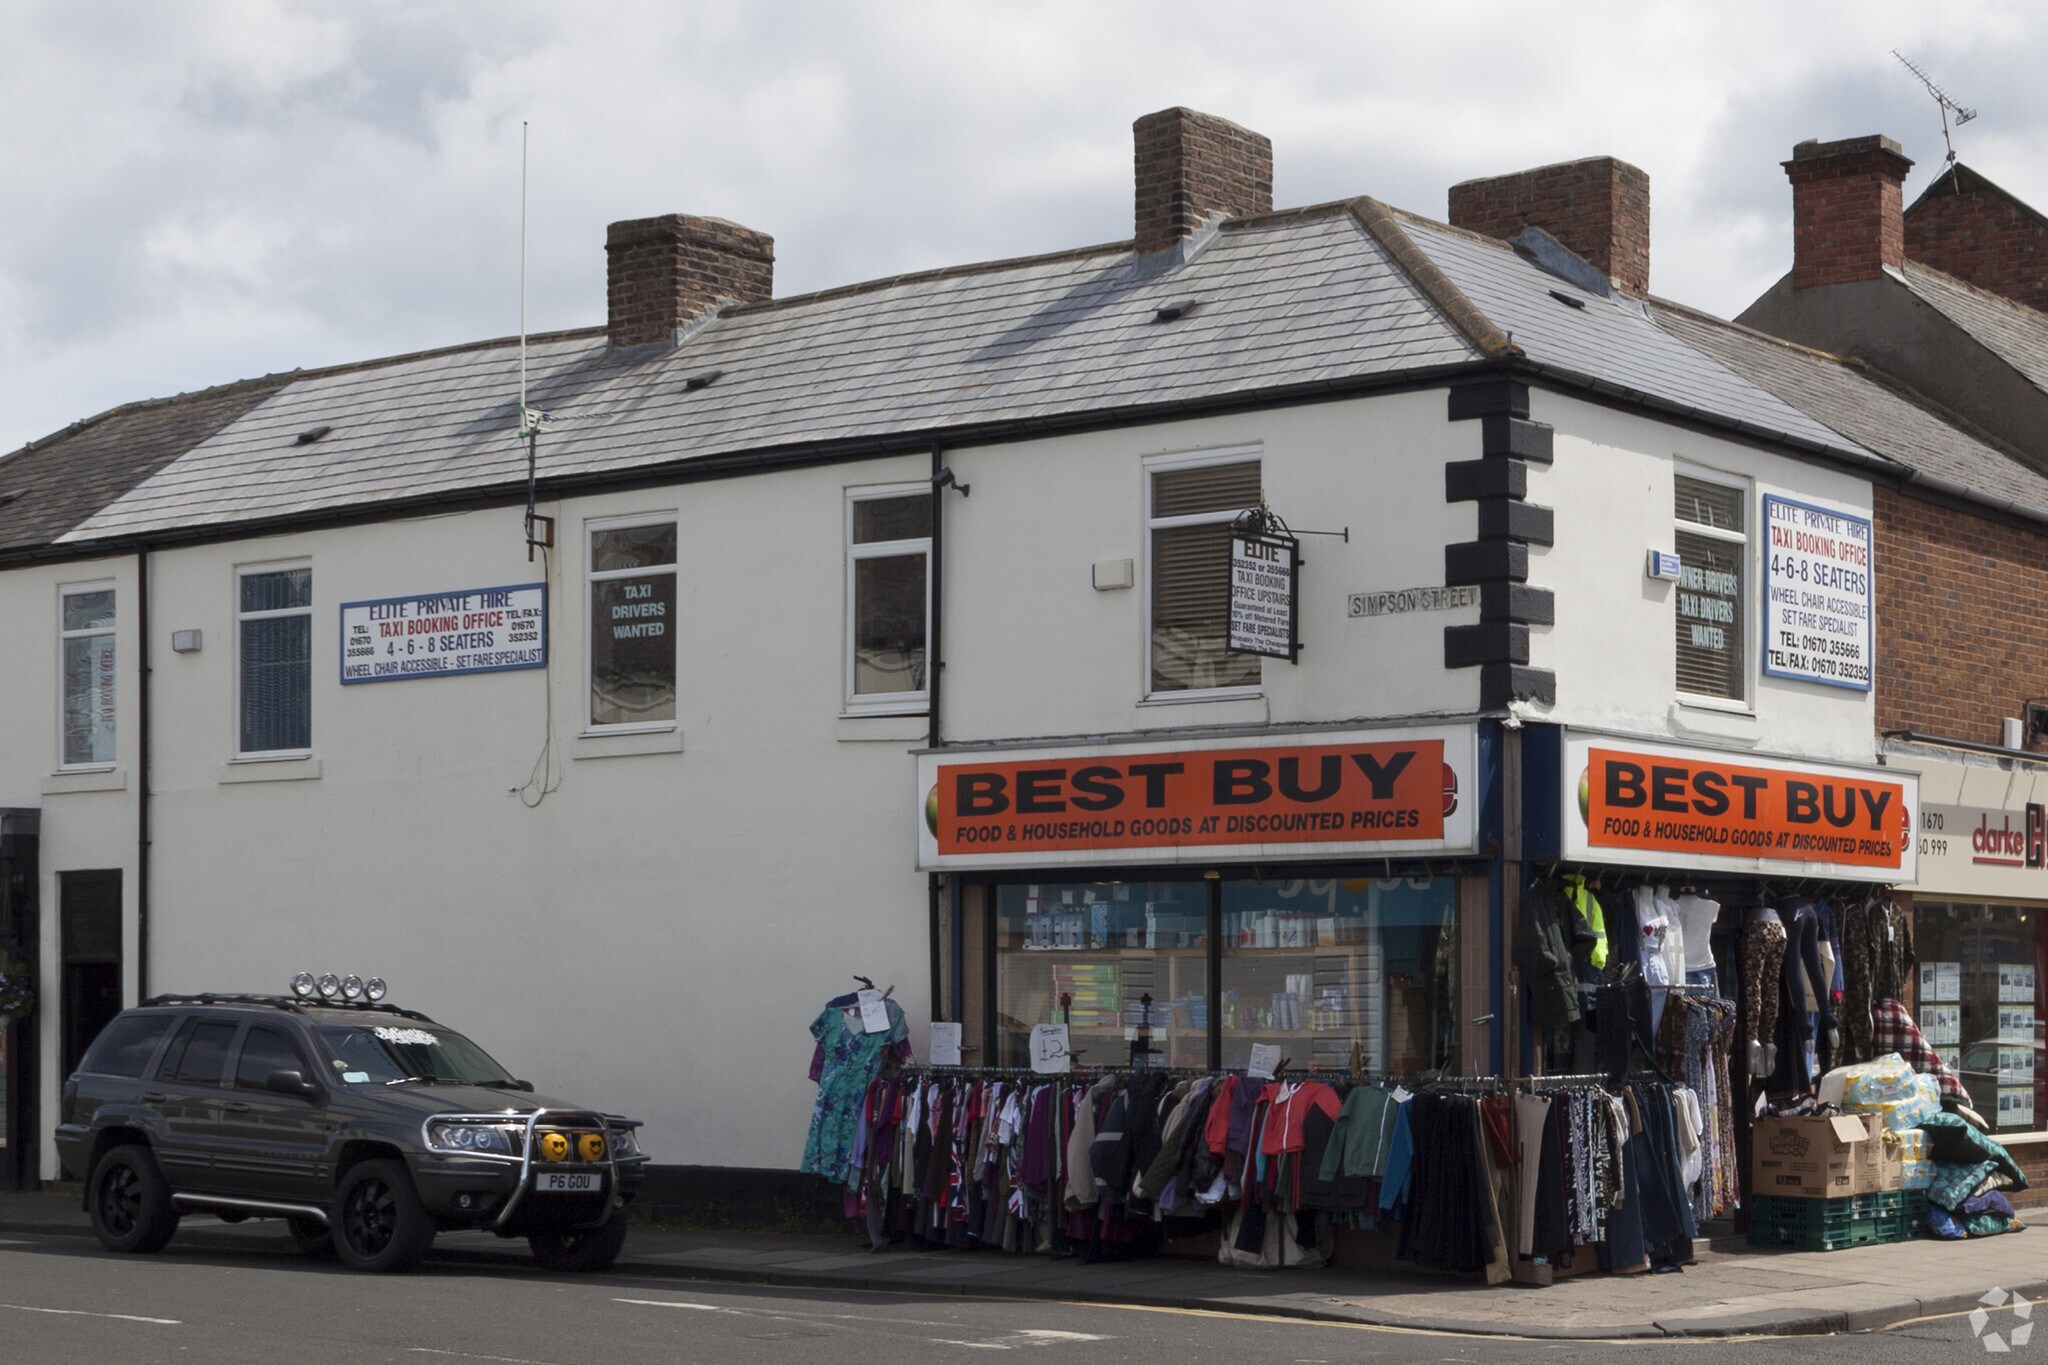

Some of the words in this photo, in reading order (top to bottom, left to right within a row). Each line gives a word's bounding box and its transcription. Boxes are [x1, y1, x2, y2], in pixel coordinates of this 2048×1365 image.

[1770, 502, 1798, 524] ELITE
[1804, 510, 1841, 535] PRIVATE
[1847, 521, 1868, 541] HIRE
[1244, 540, 1280, 562] ELITE
[1771, 525, 1793, 548] TAXI
[1796, 531, 1836, 559] BOOKING
[1839, 540, 1866, 567] OFFICE
[1232, 558, 1257, 571] 352352
[1266, 564, 1291, 577] 355666
[1771, 553, 1808, 582] 4-6-8
[1814, 561, 1866, 595] SEATERS
[624, 584, 651, 599] TAXI
[1237, 570, 1253, 584] TAXI
[1255, 575, 1286, 590] BOOKING
[1676, 566, 1703, 590] WNER
[1706, 570, 1738, 596] DRIVERS
[369, 603, 408, 621] ELITE
[417, 596, 472, 616] PRIVATE
[480, 591, 514, 609] HIRE
[1231, 585, 1255, 600] OFFICE
[1258, 589, 1290, 606] UPSTAIRS
[1353, 593, 1416, 614] SIMPSON
[1421, 588, 1477, 609] STREET
[1768, 584, 1798, 607] WHEEL
[1801, 591, 1825, 611] CHAIR
[1827, 596, 1866, 620] ACCESSIBLE
[506, 608, 542, 620] TEL/FAX:
[612, 602, 665, 619] DRIVERS
[1234, 600, 1265, 613] Guaranteed
[1273, 607, 1288, 617] Least
[1254, 613, 1277, 625] Metered
[1680, 593, 1698, 617] TAXI
[1701, 598, 1734, 624] DRIVERS
[353, 625, 369, 634] TEL:
[379, 622, 403, 639] TAXI
[408, 615, 459, 635] BOOKING
[463, 610, 503, 630] OFFICE
[511, 620, 535, 631] 01670
[613, 622, 664, 639] WANTED
[1231, 620, 1241, 632] SET
[1243, 621, 1256, 634] FARE
[1257, 624, 1290, 639] SPECIALISTS
[1782, 608, 1797, 627] SET
[1799, 612, 1817, 630] FARE
[1818, 615, 1858, 638] SPECIALIST
[350, 636, 371, 646] 01670
[386, 641, 395, 657] 4
[407, 639, 415, 655] 6
[428, 637, 435, 653] 8
[440, 631, 494, 652] SEATERS
[508, 631, 538, 643] 352352
[1692, 624, 1724, 649] WANTED
[1780, 630, 1800, 649] TEL:
[1802, 634, 1827, 654] 01670
[1829, 638, 1860, 660] 355666
[345, 661, 373, 677] WHEEL
[374, 659, 398, 675] CHAIR
[400, 657, 447, 673] ACCESSIBLE
[456, 654, 471, 668] SET
[473, 653, 494, 667] FARE
[494, 649, 542, 665] SPECIALIST
[346, 647, 375, 658] 355666
[1769, 650, 1810, 671] TEL/FAX:
[1811, 656, 1837, 676] 01670
[1838, 661, 1868, 681] 352352
[956, 762, 1185, 817] BEST
[1213, 751, 1417, 806] BUY
[1605, 760, 1768, 820] BEST
[1786, 780, 1892, 831] BUY
[956, 825, 1001, 843] FOOD
[1006, 826, 1017, 841] &
[1022, 820, 1125, 841] HOUSEHOLD
[1130, 817, 1192, 836] GOODS
[1198, 815, 1220, 833] AT
[1226, 812, 1344, 833] DISCOUNTED
[1350, 809, 1419, 829] PRICES
[1919, 812, 1944, 830] 1670
[1603, 817, 1640, 837] FOOD
[1643, 823, 1652, 838] &
[1654, 821, 1728, 845] HOUSEHOLD
[1731, 829, 1772, 848] GOODS
[1775, 832, 1791, 849] AT
[1792, 834, 1856, 855] DISCOUNTED
[1858, 840, 1892, 857] PRICES
[1931, 839, 1948, 856] 999
[549, 1175, 566, 1188] P6
[568, 1175, 591, 1189] GOU
